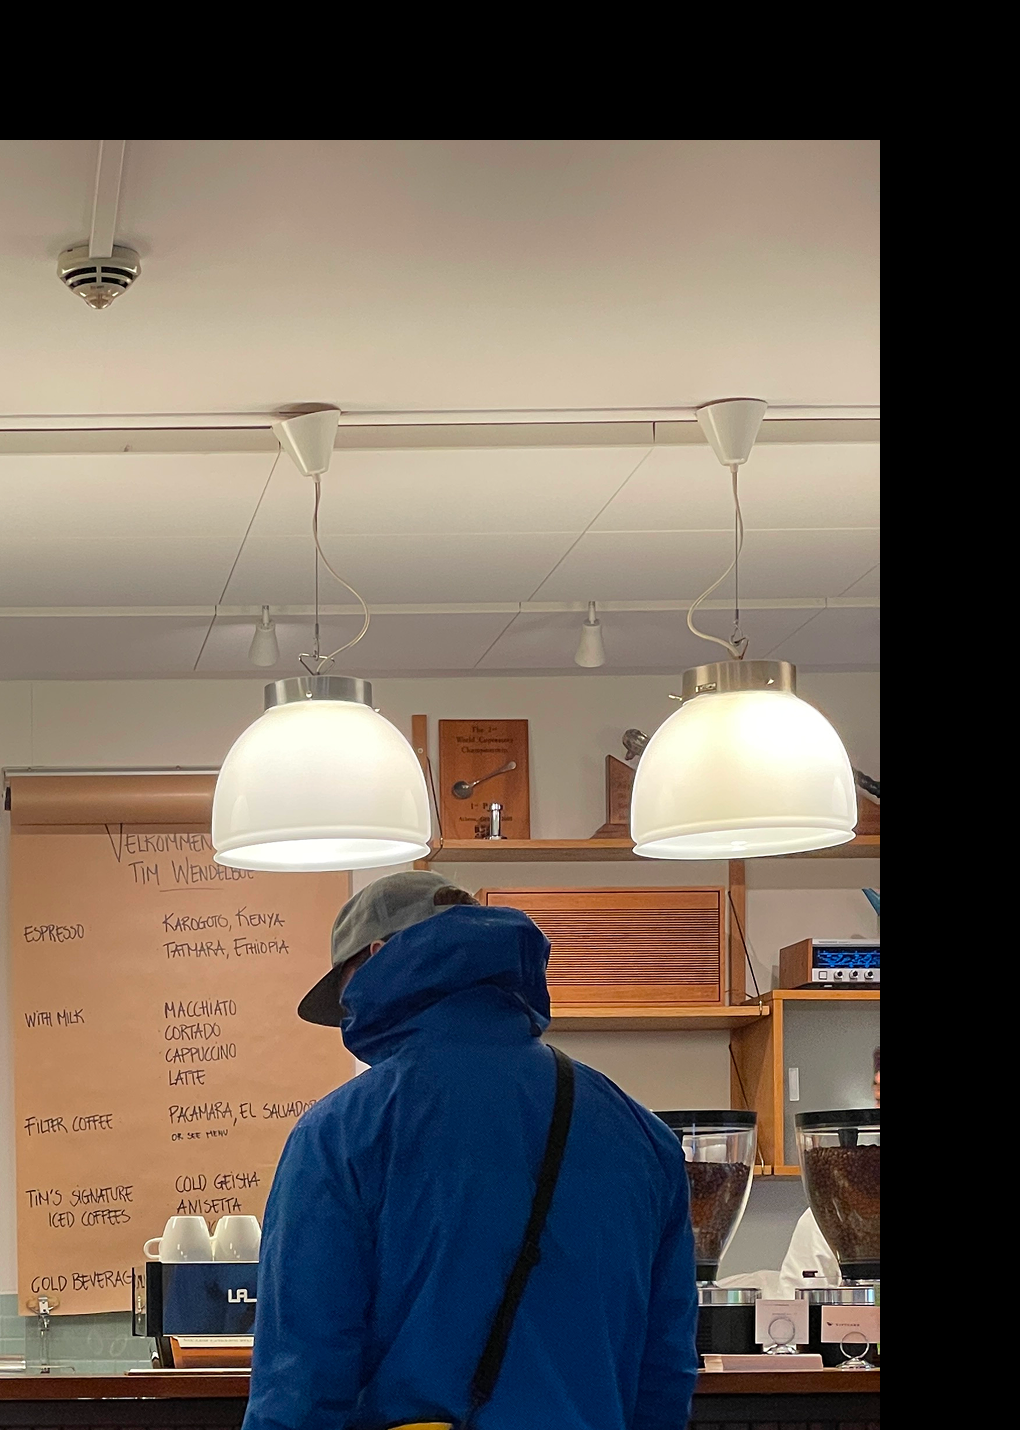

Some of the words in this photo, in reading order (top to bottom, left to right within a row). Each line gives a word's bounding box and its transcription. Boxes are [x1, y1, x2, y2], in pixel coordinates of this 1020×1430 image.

[128, 860, 160, 886] TIM
[235, 906, 286, 928] KENYA
[23, 923, 85, 943] ESPRESSO
[233, 937, 290, 957] ETHIOPIA
[24, 1010, 53, 1028] WITH
[56, 1006, 85, 1027] MILK
[164, 997, 237, 1019] MACCHIATO
[164, 1022, 222, 1041] CORTADO
[165, 1041, 237, 1064] CAPPUCCINO
[168, 1069, 206, 1087] LATTE
[239, 1102, 257, 1119] EL
[23, 1116, 69, 1137] FILTER
[72, 1113, 114, 1132] COFFEE
[171, 1132, 184, 1141] OR
[187, 1131, 201, 1140] SEE
[205, 1128, 229, 1139] MENU
[175, 1173, 207, 1193] COLD
[213, 1171, 261, 1191] GEISHA
[25, 1188, 63, 1208] TIM'S
[69, 1184, 134, 1207] SIGNATURE
[176, 1197, 242, 1215] ANISETTA
[48, 1210, 75, 1228] ICED
[81, 1208, 132, 1227] COFFEES
[31, 1275, 68, 1294] COLD
